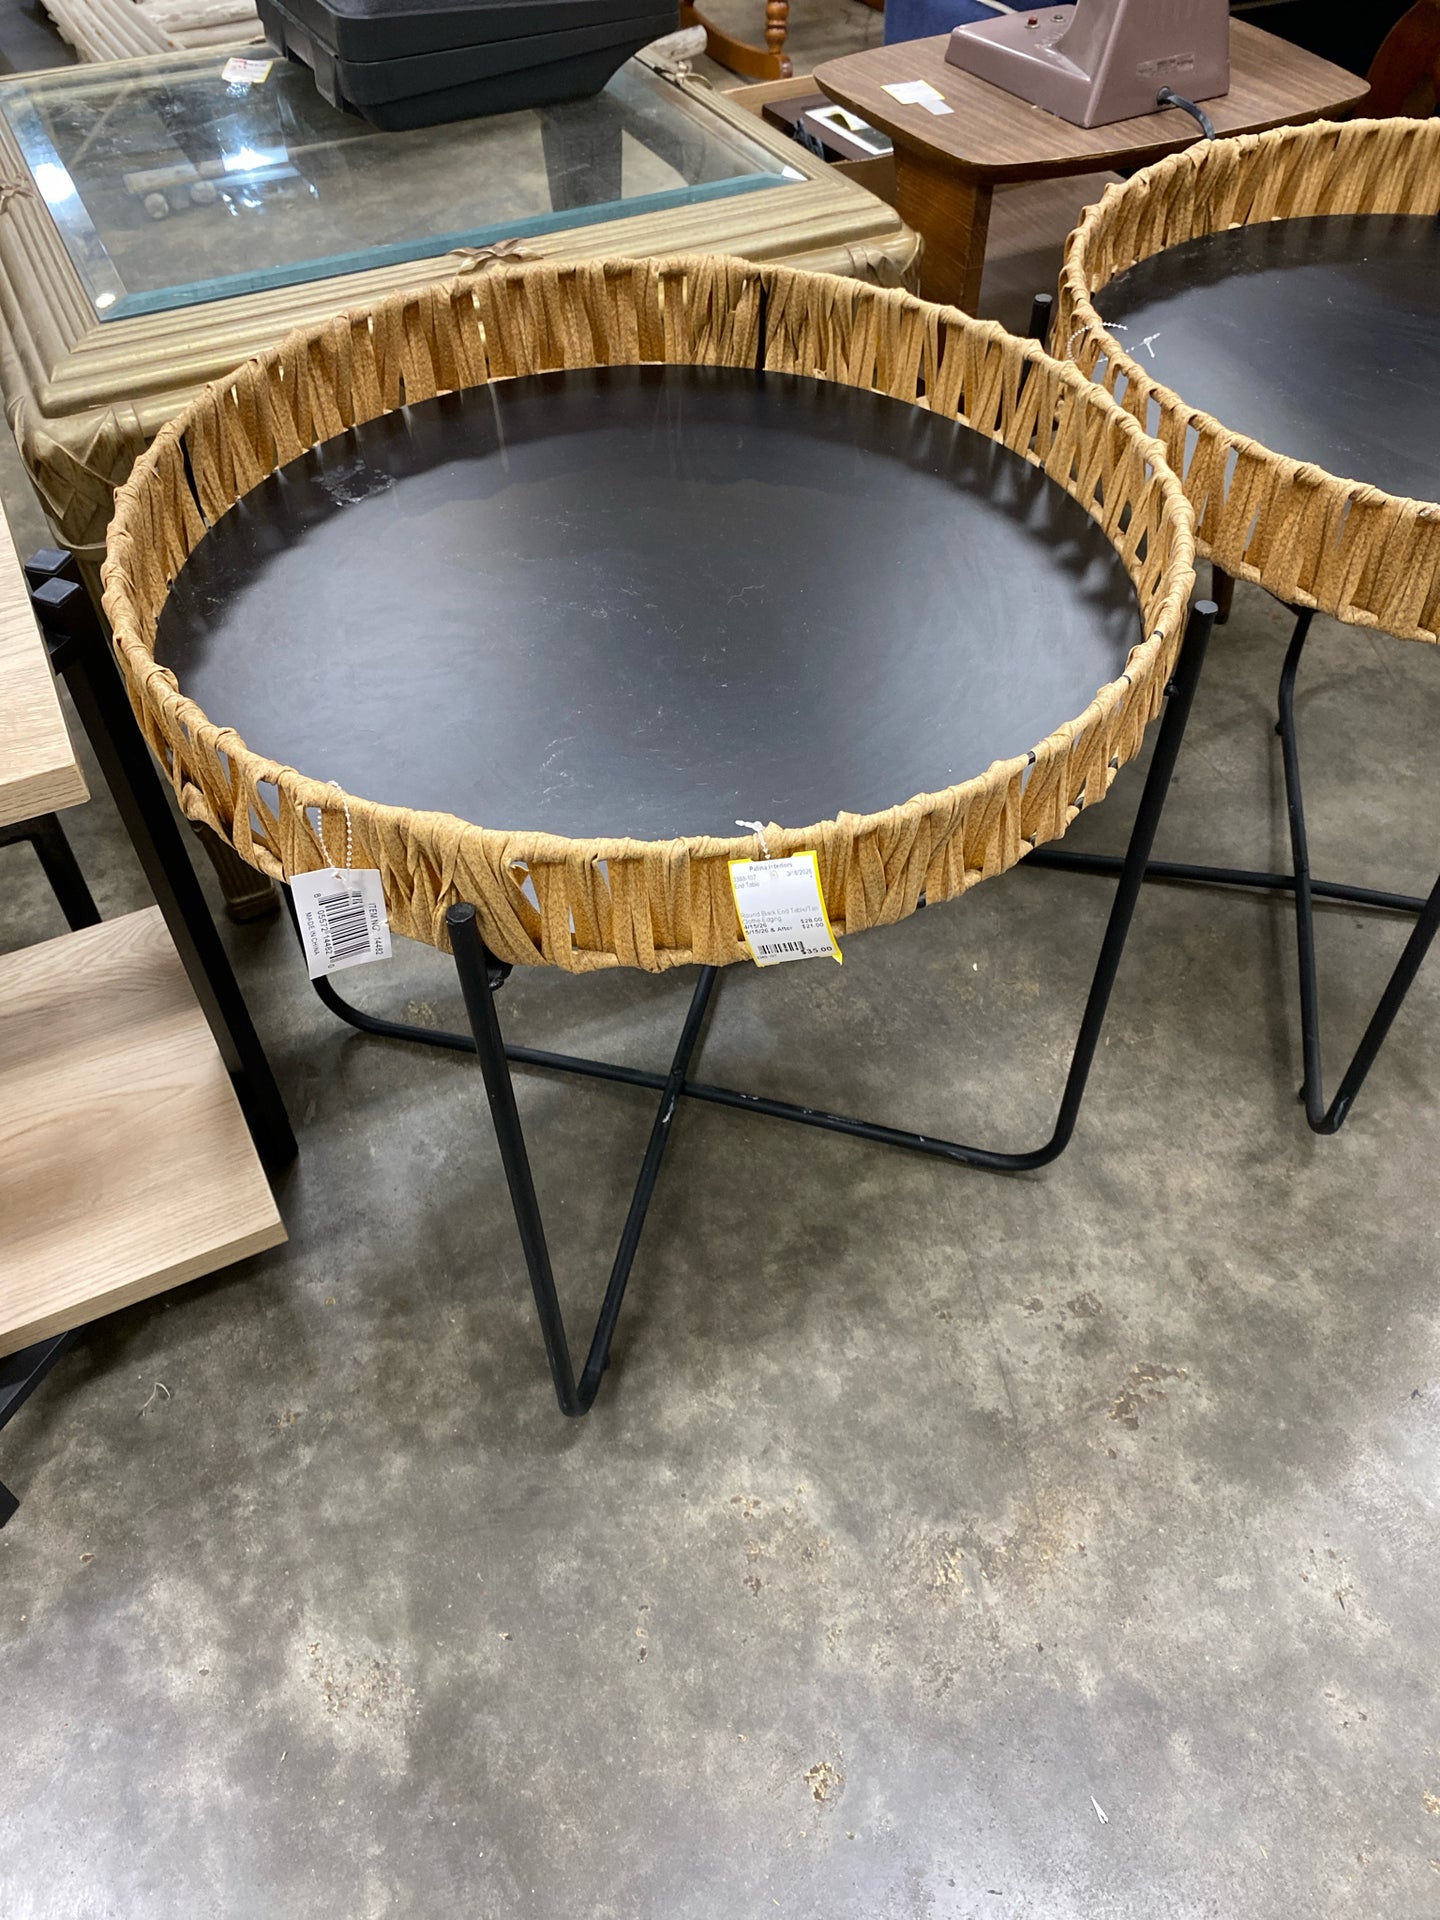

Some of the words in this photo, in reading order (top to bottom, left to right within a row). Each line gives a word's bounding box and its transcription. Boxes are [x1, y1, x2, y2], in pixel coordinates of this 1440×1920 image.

[305, 912, 315, 930] MADE
[317, 910, 328, 932] 05572
[323, 935, 333, 955] 14482
